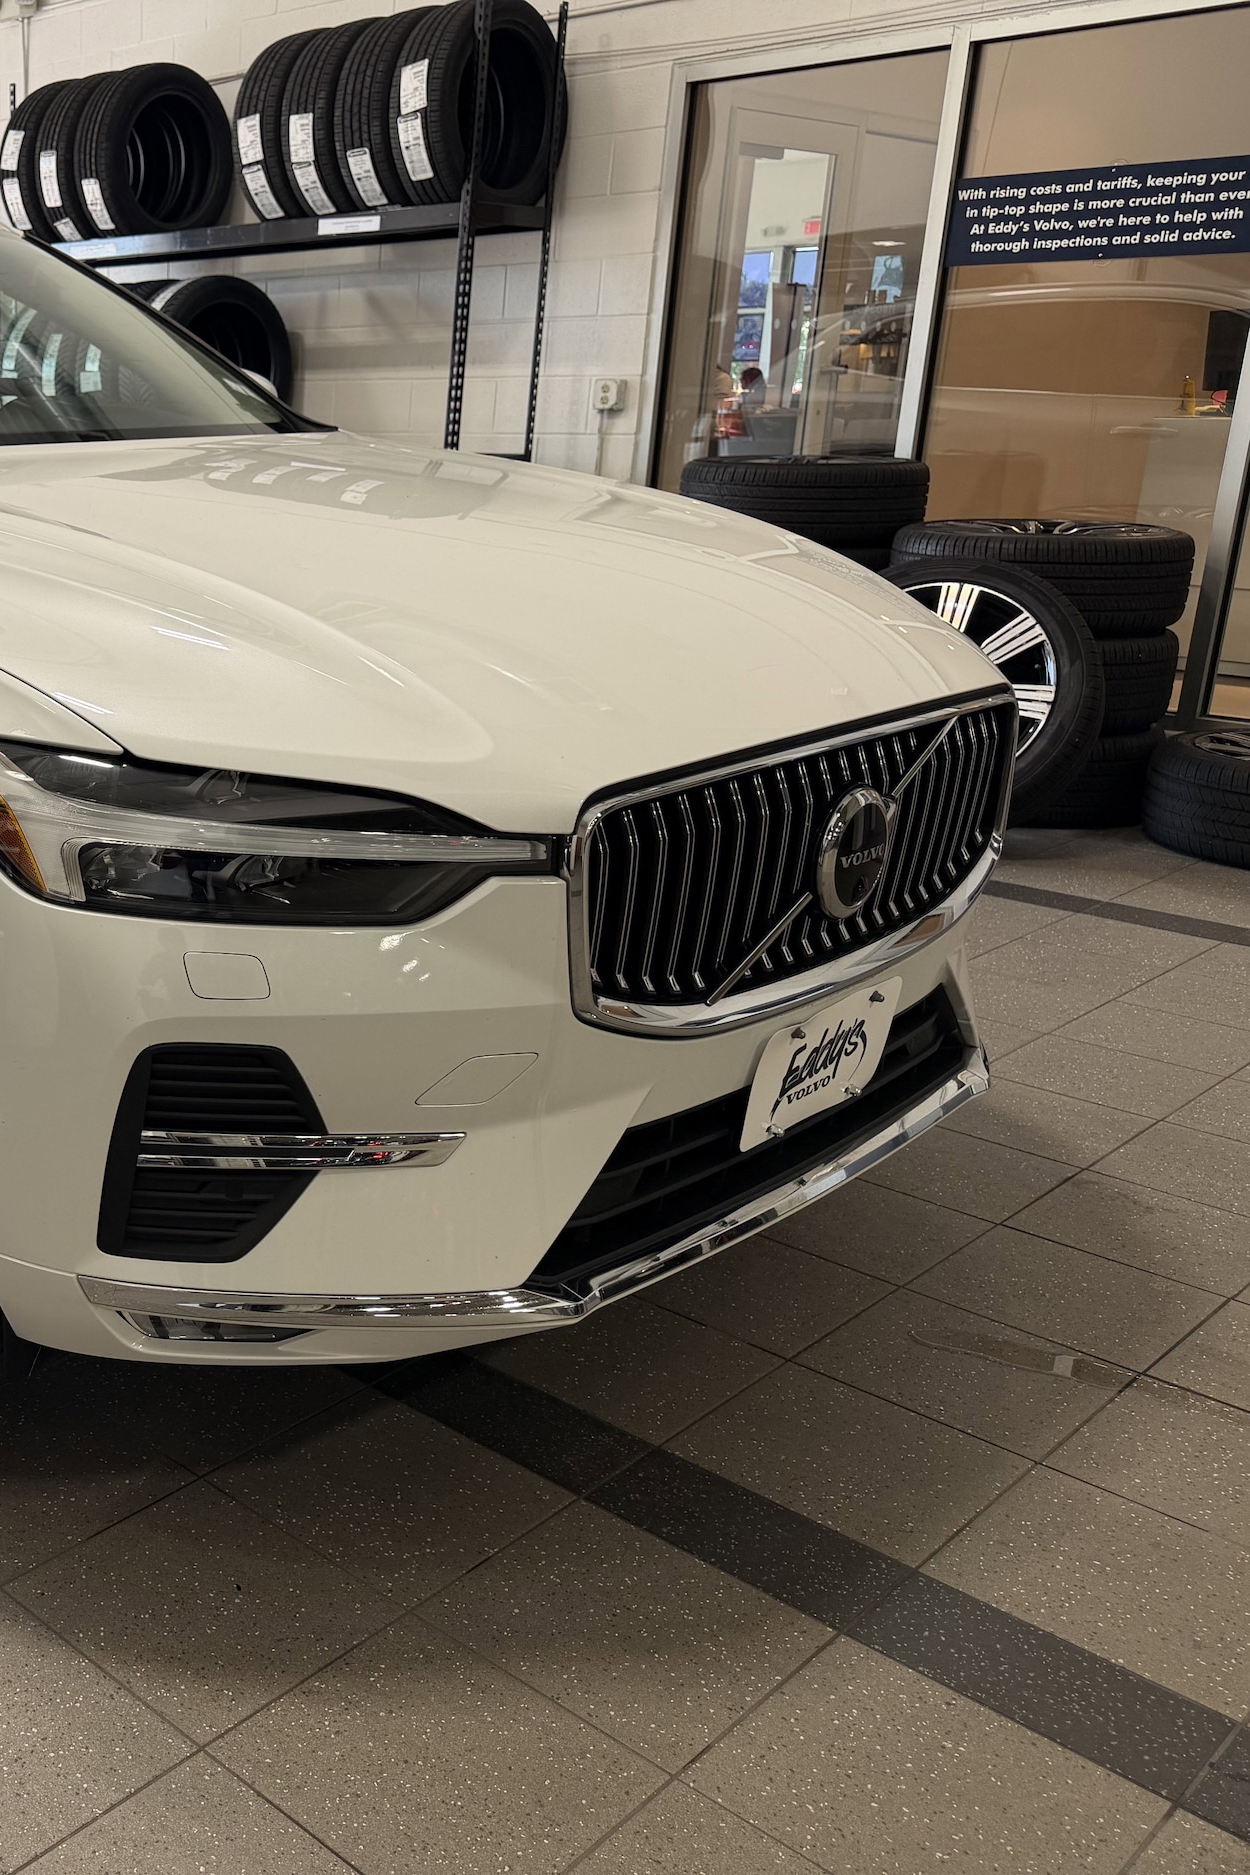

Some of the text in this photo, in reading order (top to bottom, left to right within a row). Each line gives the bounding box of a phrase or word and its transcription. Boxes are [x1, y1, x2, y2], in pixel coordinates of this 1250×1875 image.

[958, 170, 1247, 201] With rising costs and tariffs, keeping your
[965, 207, 978, 218] in
[981, 205, 1026, 219] tip-top
[1029, 201, 1070, 215] shape
[1073, 199, 1085, 211] is
[1088, 198, 1125, 210] more
[1128, 192, 1177, 207] crucial
[1180, 191, 1215, 204] than
[970, 207, 1244, 235] At Eddy's Volvo, we're here to help with
[970, 228, 1236, 253] thorough inspections and solid advice.
[839, 843, 885, 869] VOLVO
[785, 1075, 831, 1105] VOLVO
